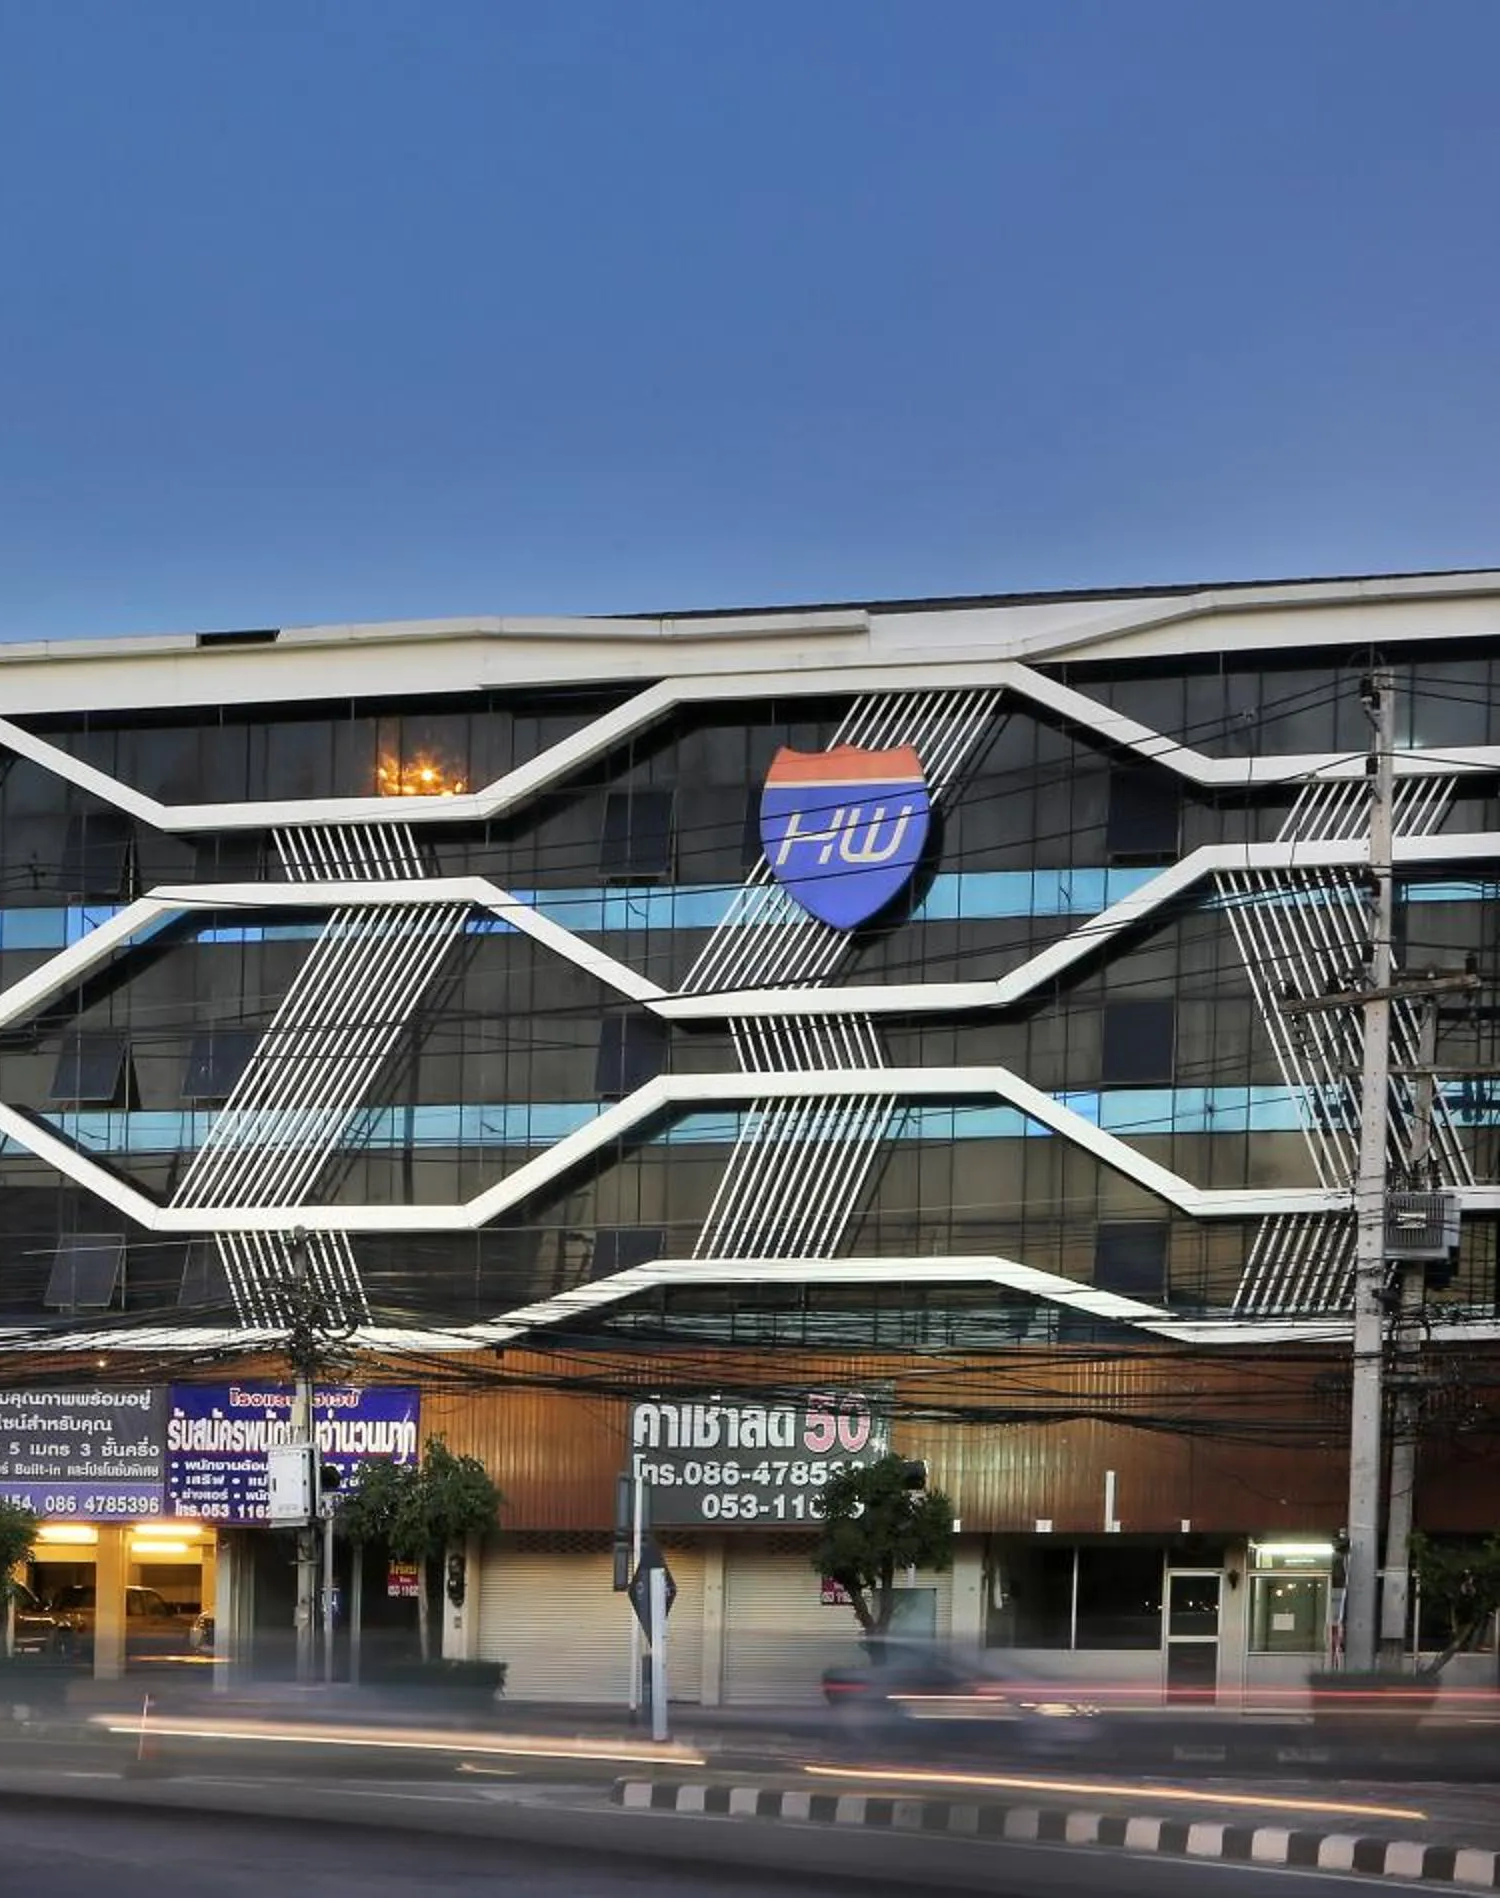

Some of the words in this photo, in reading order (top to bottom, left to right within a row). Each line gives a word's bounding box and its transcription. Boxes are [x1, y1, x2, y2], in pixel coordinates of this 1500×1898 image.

[776, 805, 913, 866] HW
[803, 1392, 871, 1454] 50
[8, 1441, 21, 1456] 5
[29, 1443, 71, 1457] เมตร
[79, 1443, 92, 1457] 3
[45, 1495, 77, 1513] 086
[84, 1495, 160, 1513] 4785396
